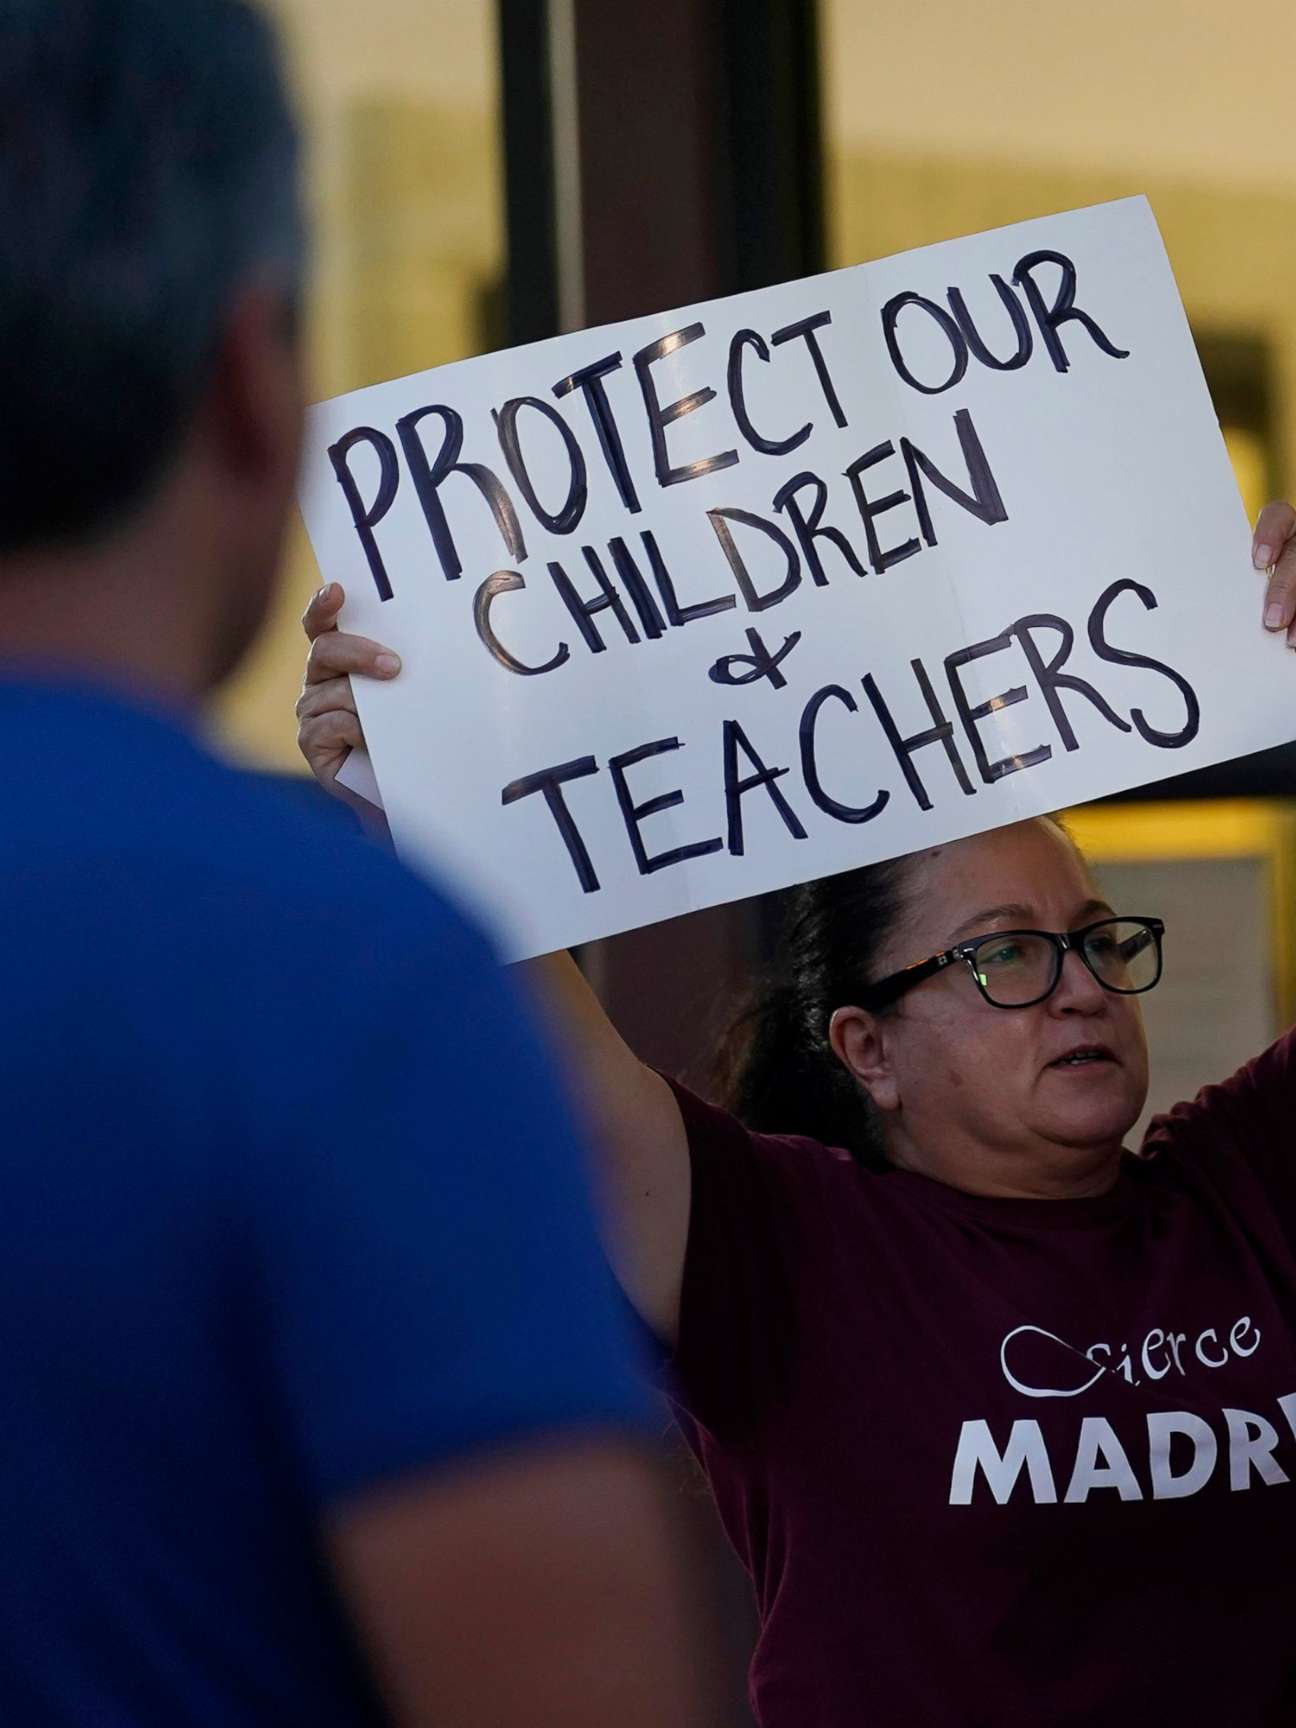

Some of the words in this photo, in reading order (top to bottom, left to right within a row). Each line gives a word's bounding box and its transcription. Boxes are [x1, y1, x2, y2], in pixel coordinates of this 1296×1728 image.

[327, 309, 849, 601] PROTECT
[880, 249, 1131, 395] OUR
[472, 408, 1009, 677] CHILDREN
[501, 578, 1201, 894] TEACHERS
[707, 625, 803, 690] &
